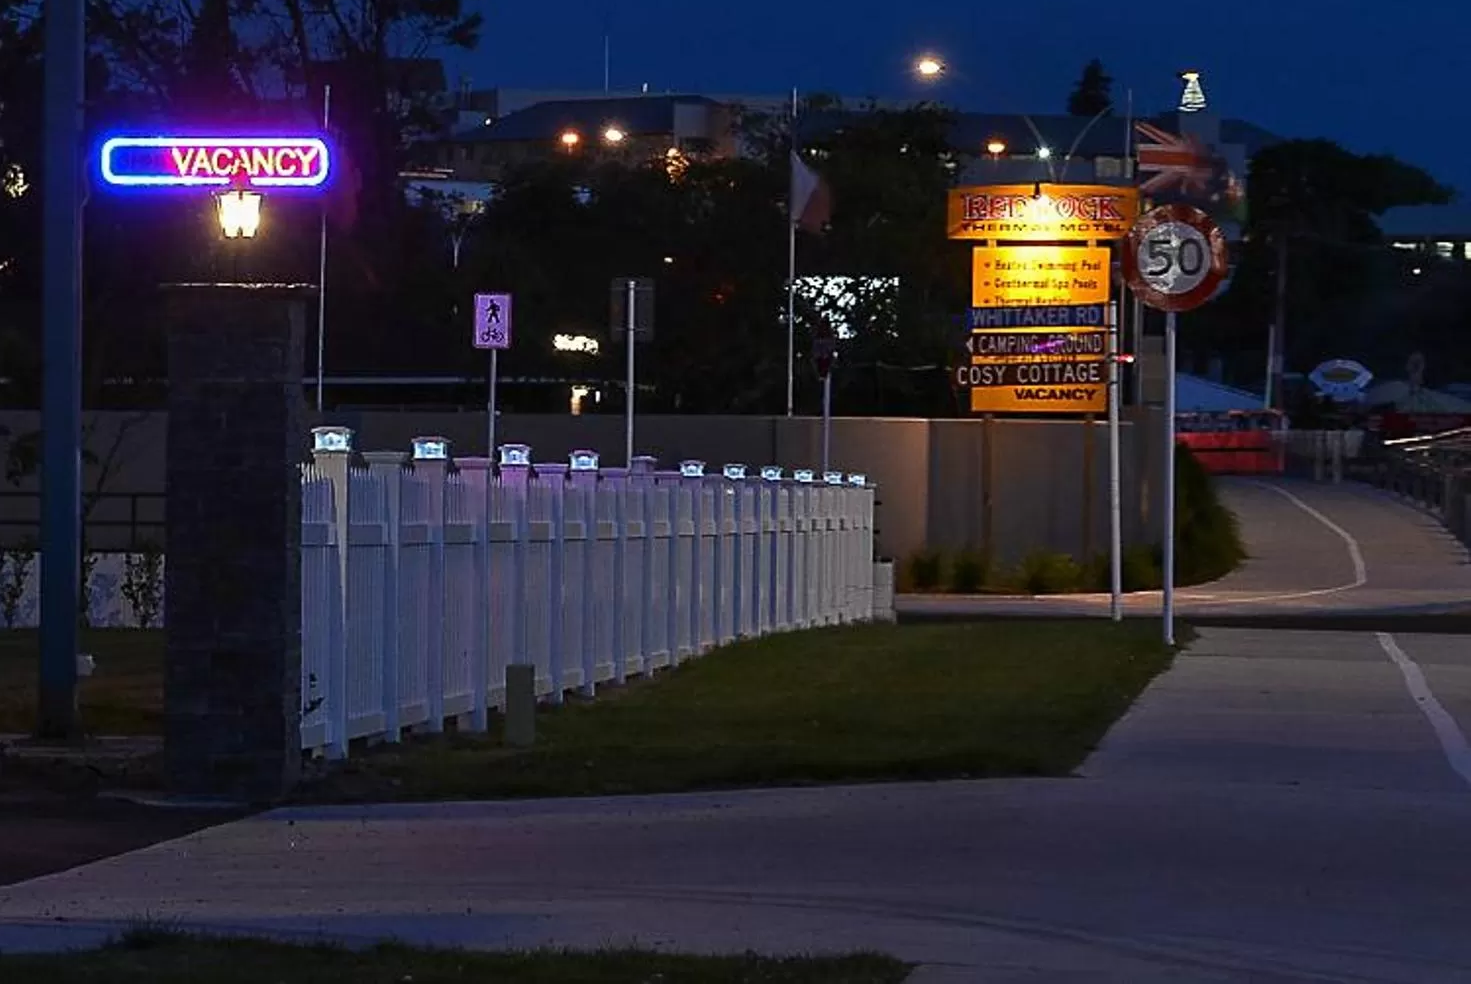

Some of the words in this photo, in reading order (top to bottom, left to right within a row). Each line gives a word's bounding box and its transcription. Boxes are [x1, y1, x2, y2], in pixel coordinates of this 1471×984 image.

[171, 147, 318, 176] VACANCY
[963, 195, 1028, 221] RED
[1034, 195, 1124, 221] OCK
[1060, 223, 1125, 232] MOTEL
[1148, 239, 1204, 276] 50
[971, 308, 1069, 327] WHITTAKER
[1076, 307, 1101, 324] RD
[978, 335, 1037, 353] CAMPING
[1048, 334, 1103, 353] GROUND
[957, 366, 1007, 385] COSY
[1017, 363, 1100, 384] COTTAGE
[1014, 389, 1097, 401] VACANCY
